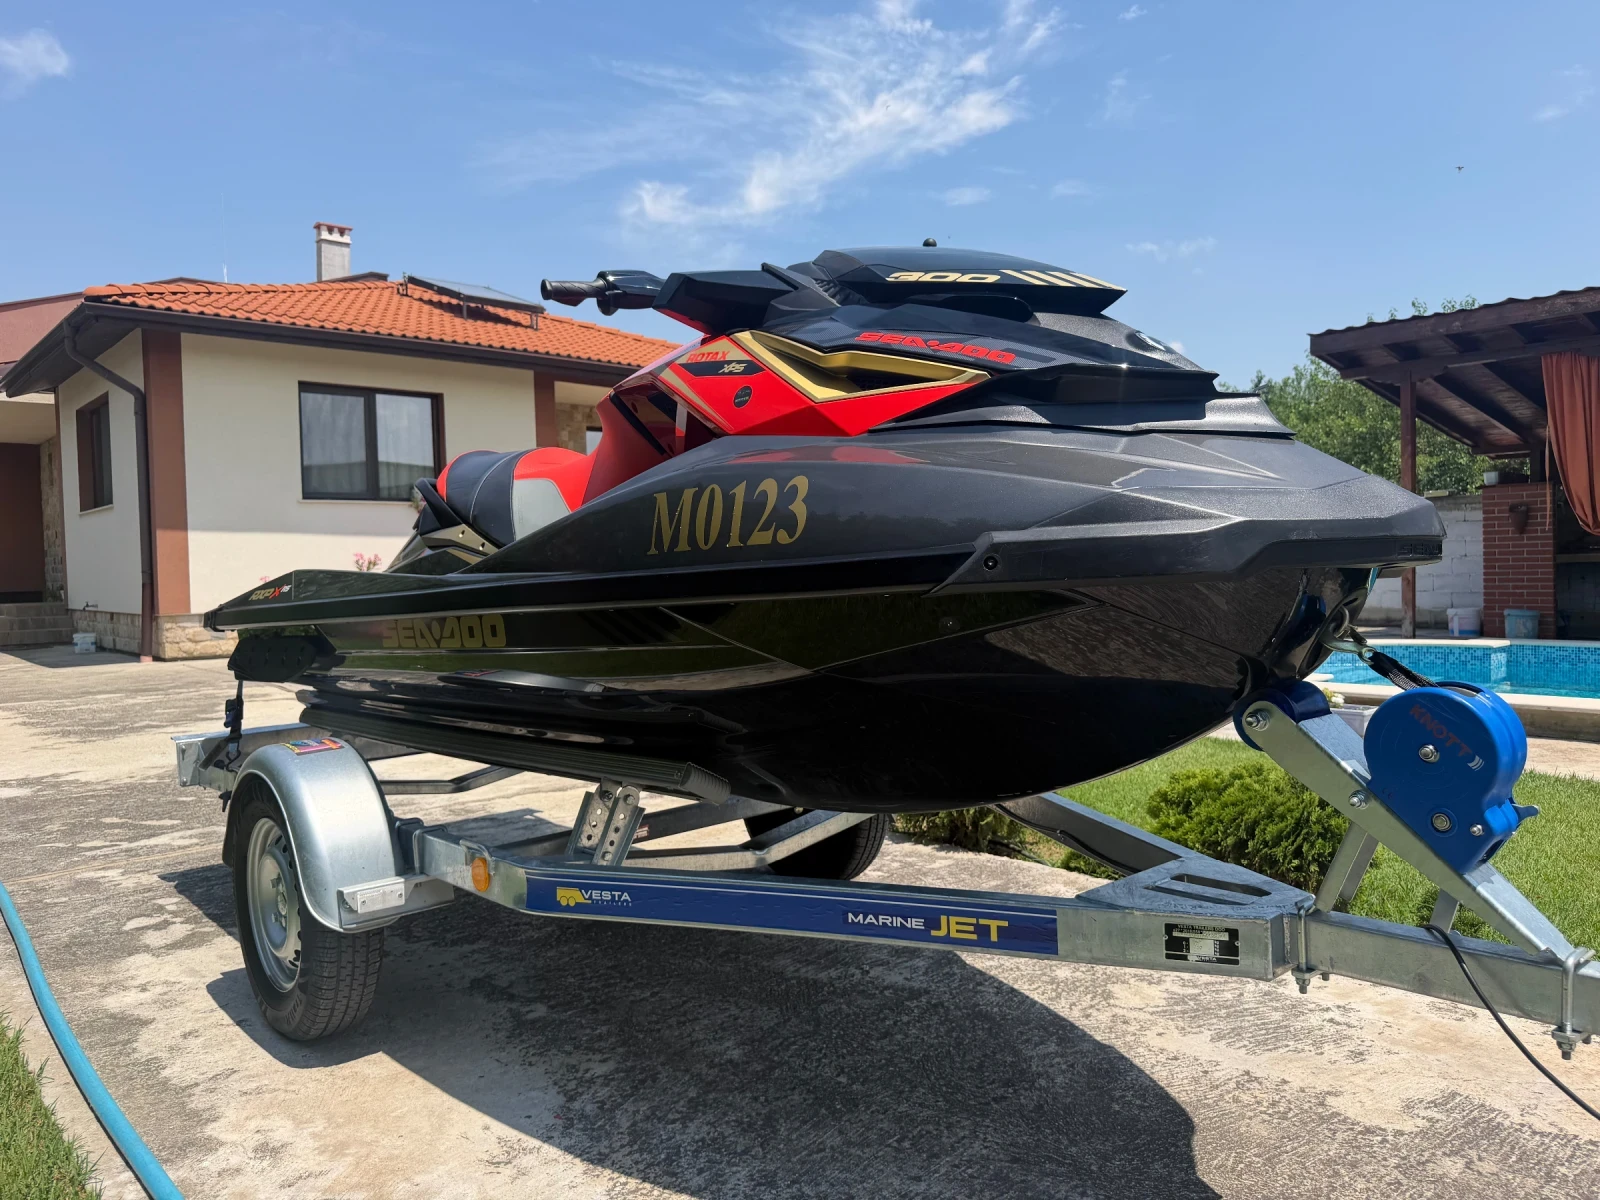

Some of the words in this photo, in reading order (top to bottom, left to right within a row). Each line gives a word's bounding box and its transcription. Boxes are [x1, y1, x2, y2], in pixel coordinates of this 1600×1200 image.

[886, 271, 1001, 283] 300
[686, 350, 731, 364] ROTAX
[1409, 704, 1473, 757] KNOTT
[581, 889, 632, 902] VESTA
[847, 912, 925, 930] MARINE
[930, 914, 1009, 942] JET
